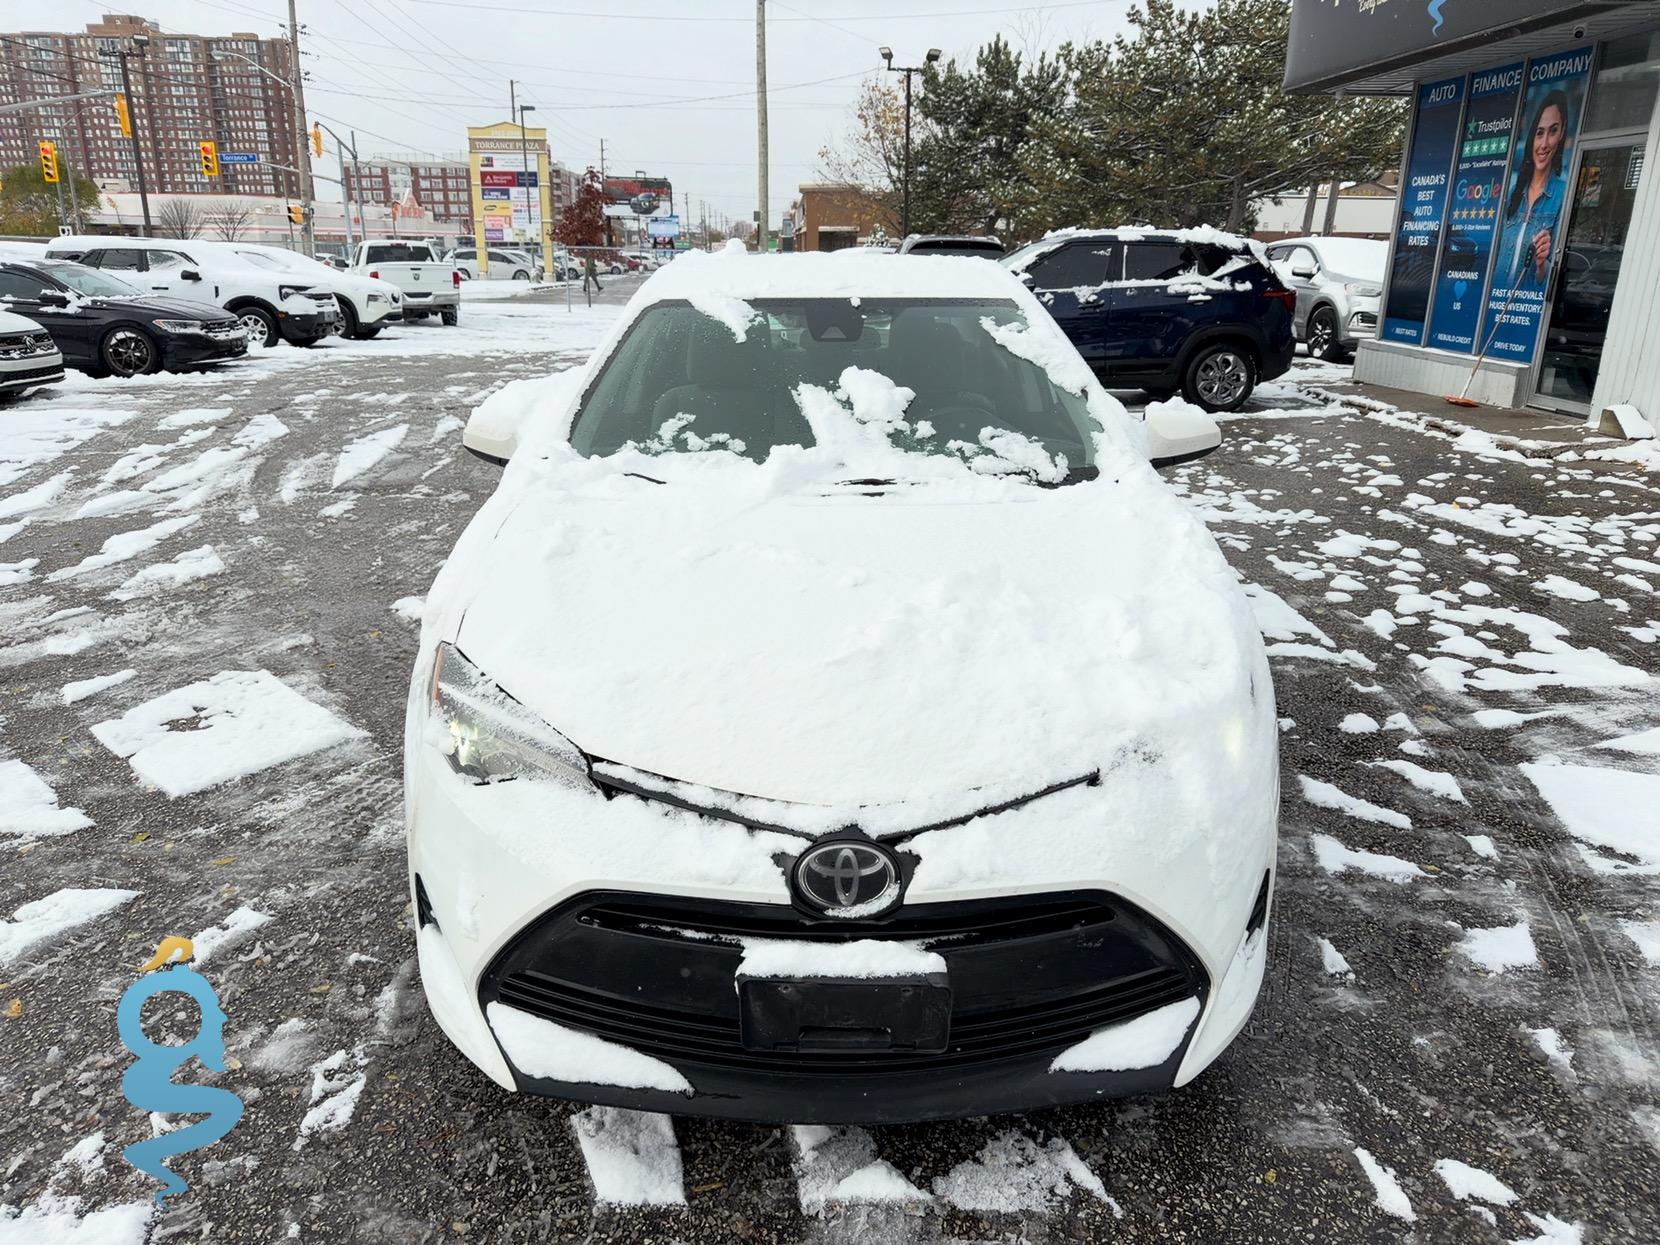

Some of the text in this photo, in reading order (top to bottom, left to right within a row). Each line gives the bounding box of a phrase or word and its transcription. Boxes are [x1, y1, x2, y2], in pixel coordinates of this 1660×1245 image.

[1428, 54, 1593, 103] AUTO FINANCE COMPANY
[1478, 117, 1512, 133] Trustpilot
[475, 141, 513, 150] TORRANCE
[1412, 174, 1446, 187] CANADA'S
[1417, 191, 1435, 201] BEST
[1456, 178, 1502, 204] Google
[1414, 206, 1432, 216] AUTO
[1403, 221, 1439, 231] FINANCING
[1408, 236, 1429, 246] RATES
[1447, 270, 1479, 280] CANADIANS
[1491, 288, 1507, 298] FAST
[1453, 302, 1461, 311] US
[1488, 301, 1505, 310] HUGE
[1510, 315, 1531, 326] RATES.
[1437, 333, 1472, 344] REBUILD CREDIT
[1494, 341, 1527, 352] DRIVE TODAY
